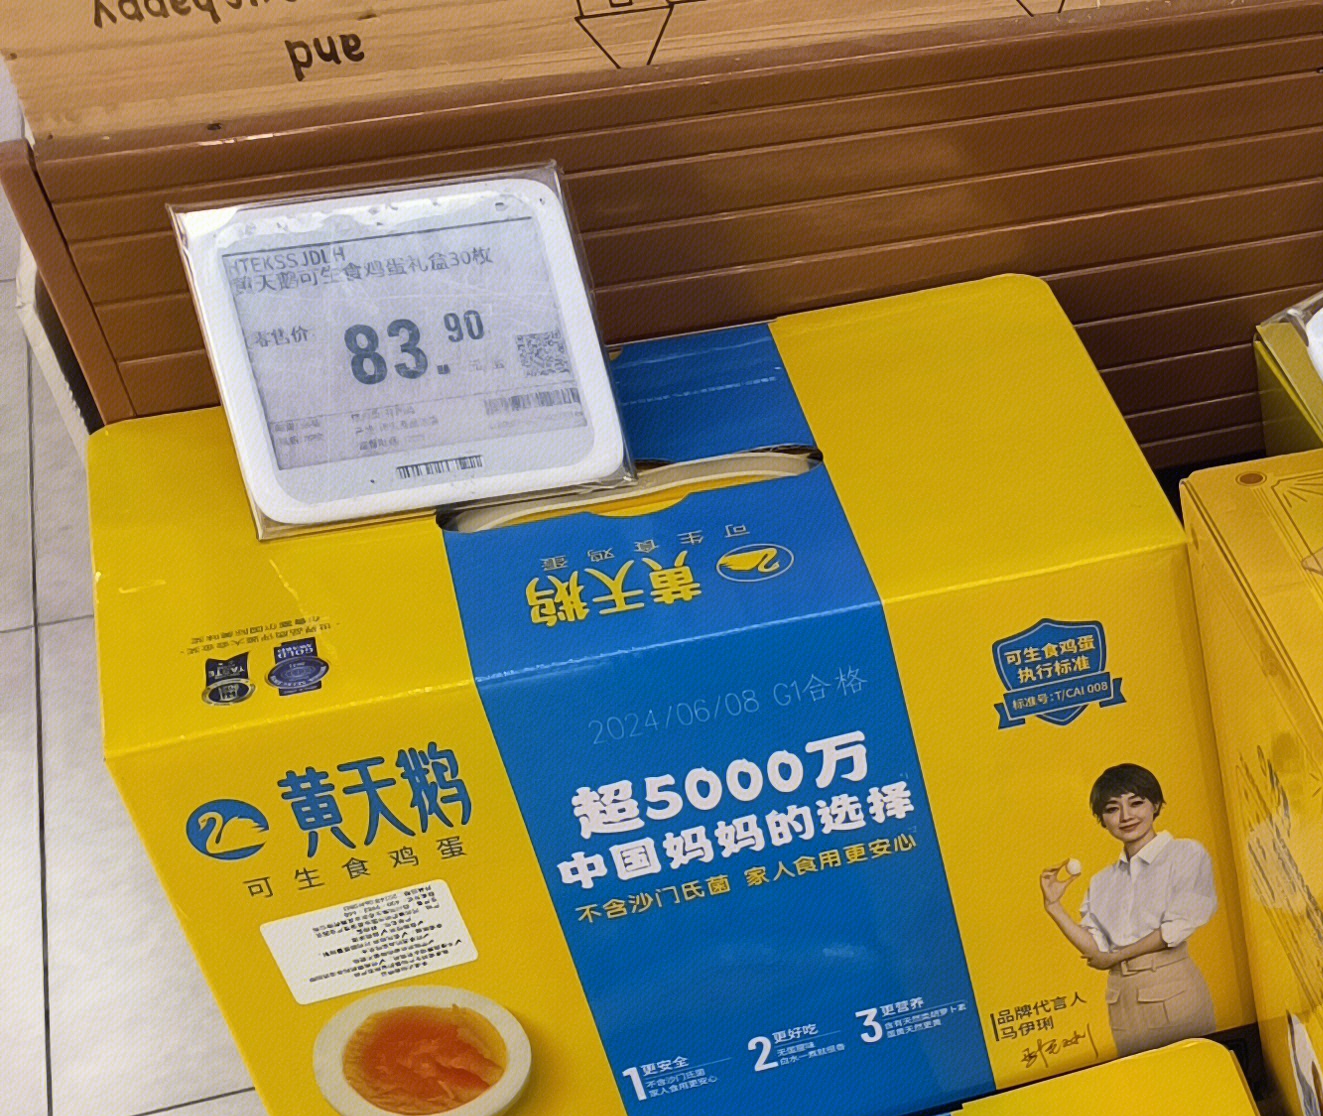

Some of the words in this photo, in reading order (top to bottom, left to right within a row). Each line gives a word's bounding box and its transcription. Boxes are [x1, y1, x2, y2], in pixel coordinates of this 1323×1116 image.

[284, 31, 366, 81] and
[539, 522, 751, 571] 可生食鸡蛋
[525, 548, 703, 627] 黄天鹅
[1004, 634, 1096, 667] 可生食鸡蛋
[1017, 656, 1092, 684] 执行标准
[1086, 680, 1110, 696] 008
[587, 686, 760, 746] 2024/06/08
[773, 664, 869, 708] G1合格
[278, 741, 473, 860] 黄天鹅
[570, 729, 870, 840] 超5000万
[556, 779, 916, 891] 中国妈妈的选择
[243, 833, 469, 899] 可生食鸡蛋
[575, 874, 732, 925] 不含沙门氏菌
[744, 831, 918, 887] 家人食用更安心
[855, 1007, 884, 1044] 3
[997, 991, 1087, 1026] 品牌代言人
[772, 1023, 819, 1045] 更好吃
[1000, 1014, 1054, 1042] 马伊琍
[640, 1055, 690, 1077] 更安全
[747, 1036, 779, 1072] 2
[622, 1066, 648, 1102] 1
